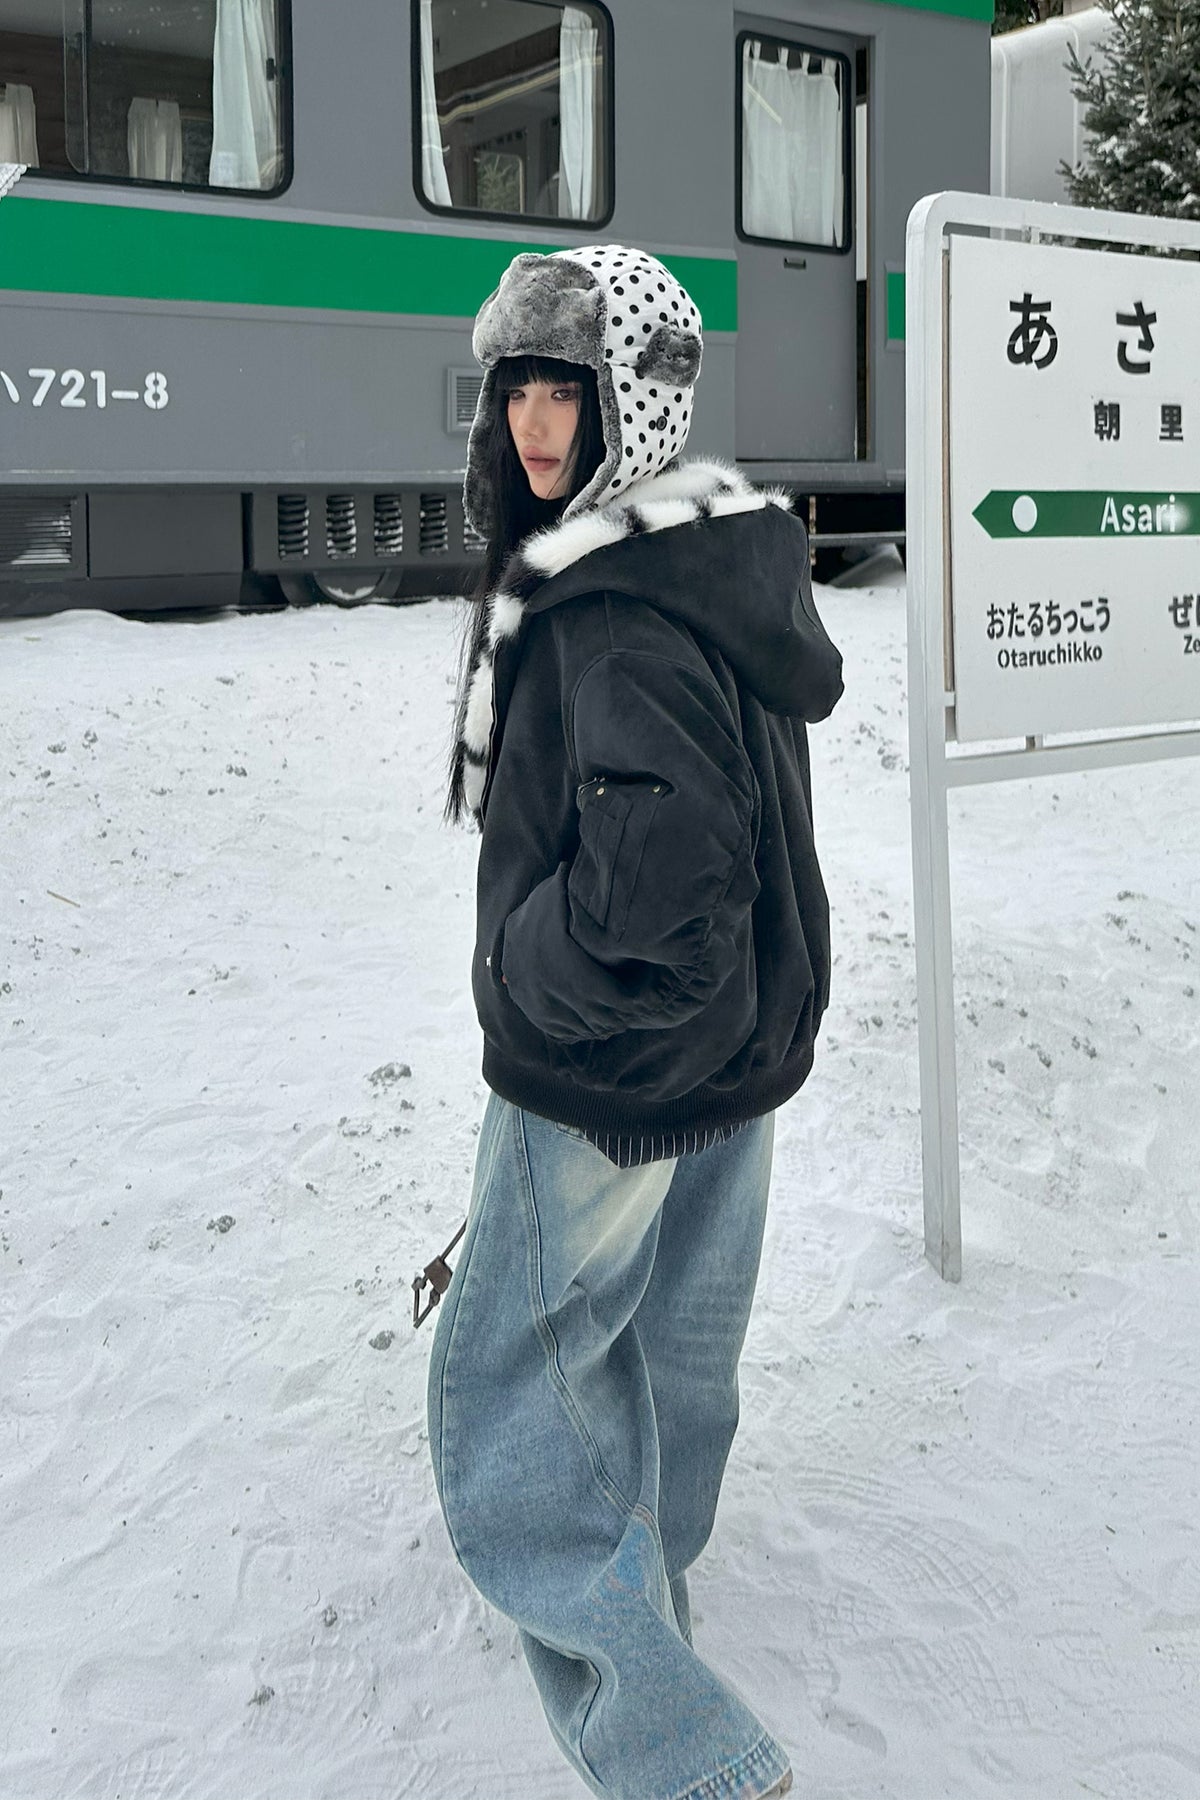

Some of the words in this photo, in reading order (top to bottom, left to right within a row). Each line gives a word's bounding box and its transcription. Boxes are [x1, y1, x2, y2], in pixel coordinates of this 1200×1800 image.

[1100, 494, 1176, 532] Asari
[986, 597, 1111, 639] おたるちっこう
[1168, 594, 1200, 628] ぜ
[997, 641, 1103, 668] Otaruchikko
